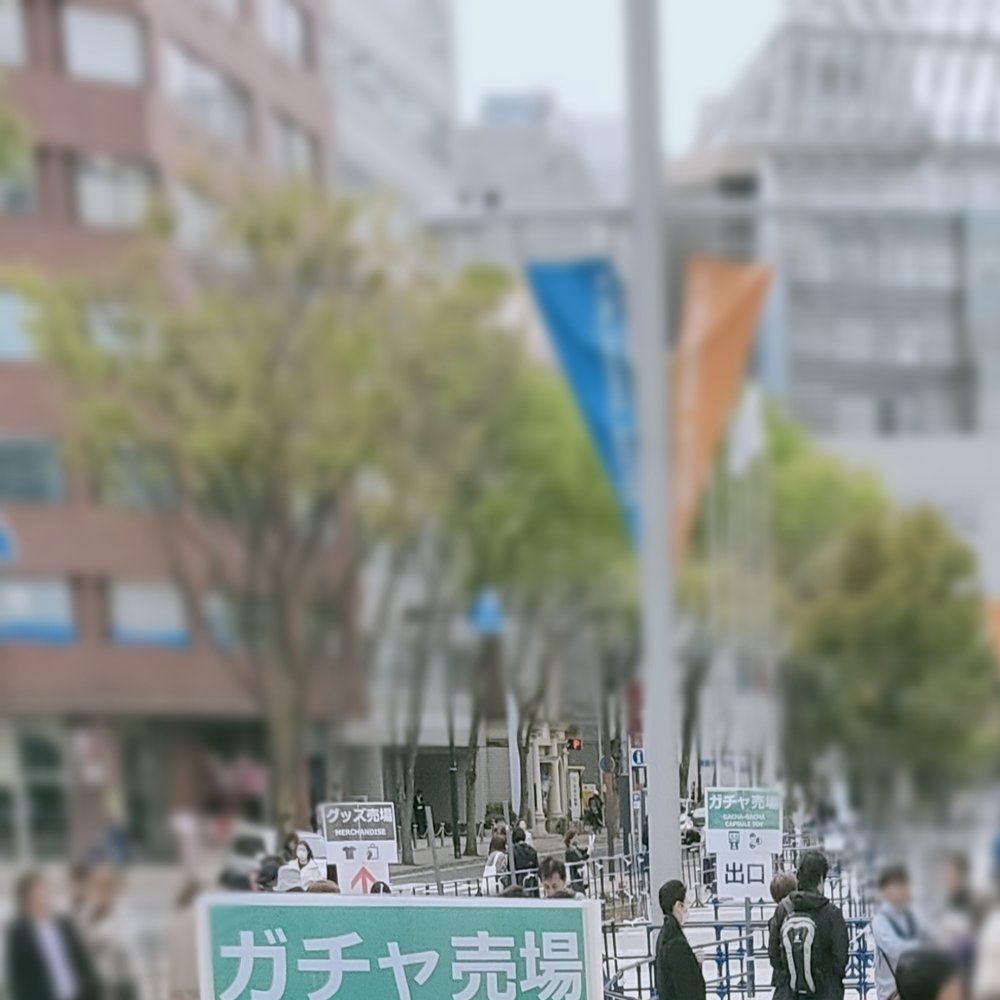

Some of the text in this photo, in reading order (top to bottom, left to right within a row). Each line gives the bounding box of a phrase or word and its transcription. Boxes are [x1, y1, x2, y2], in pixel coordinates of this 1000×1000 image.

[709, 794, 779, 810] ガチャ売場
[326, 808, 392, 823] グッズ売場
[334, 828, 387, 836] MERCHANDISE
[725, 861, 765, 884] 出口
